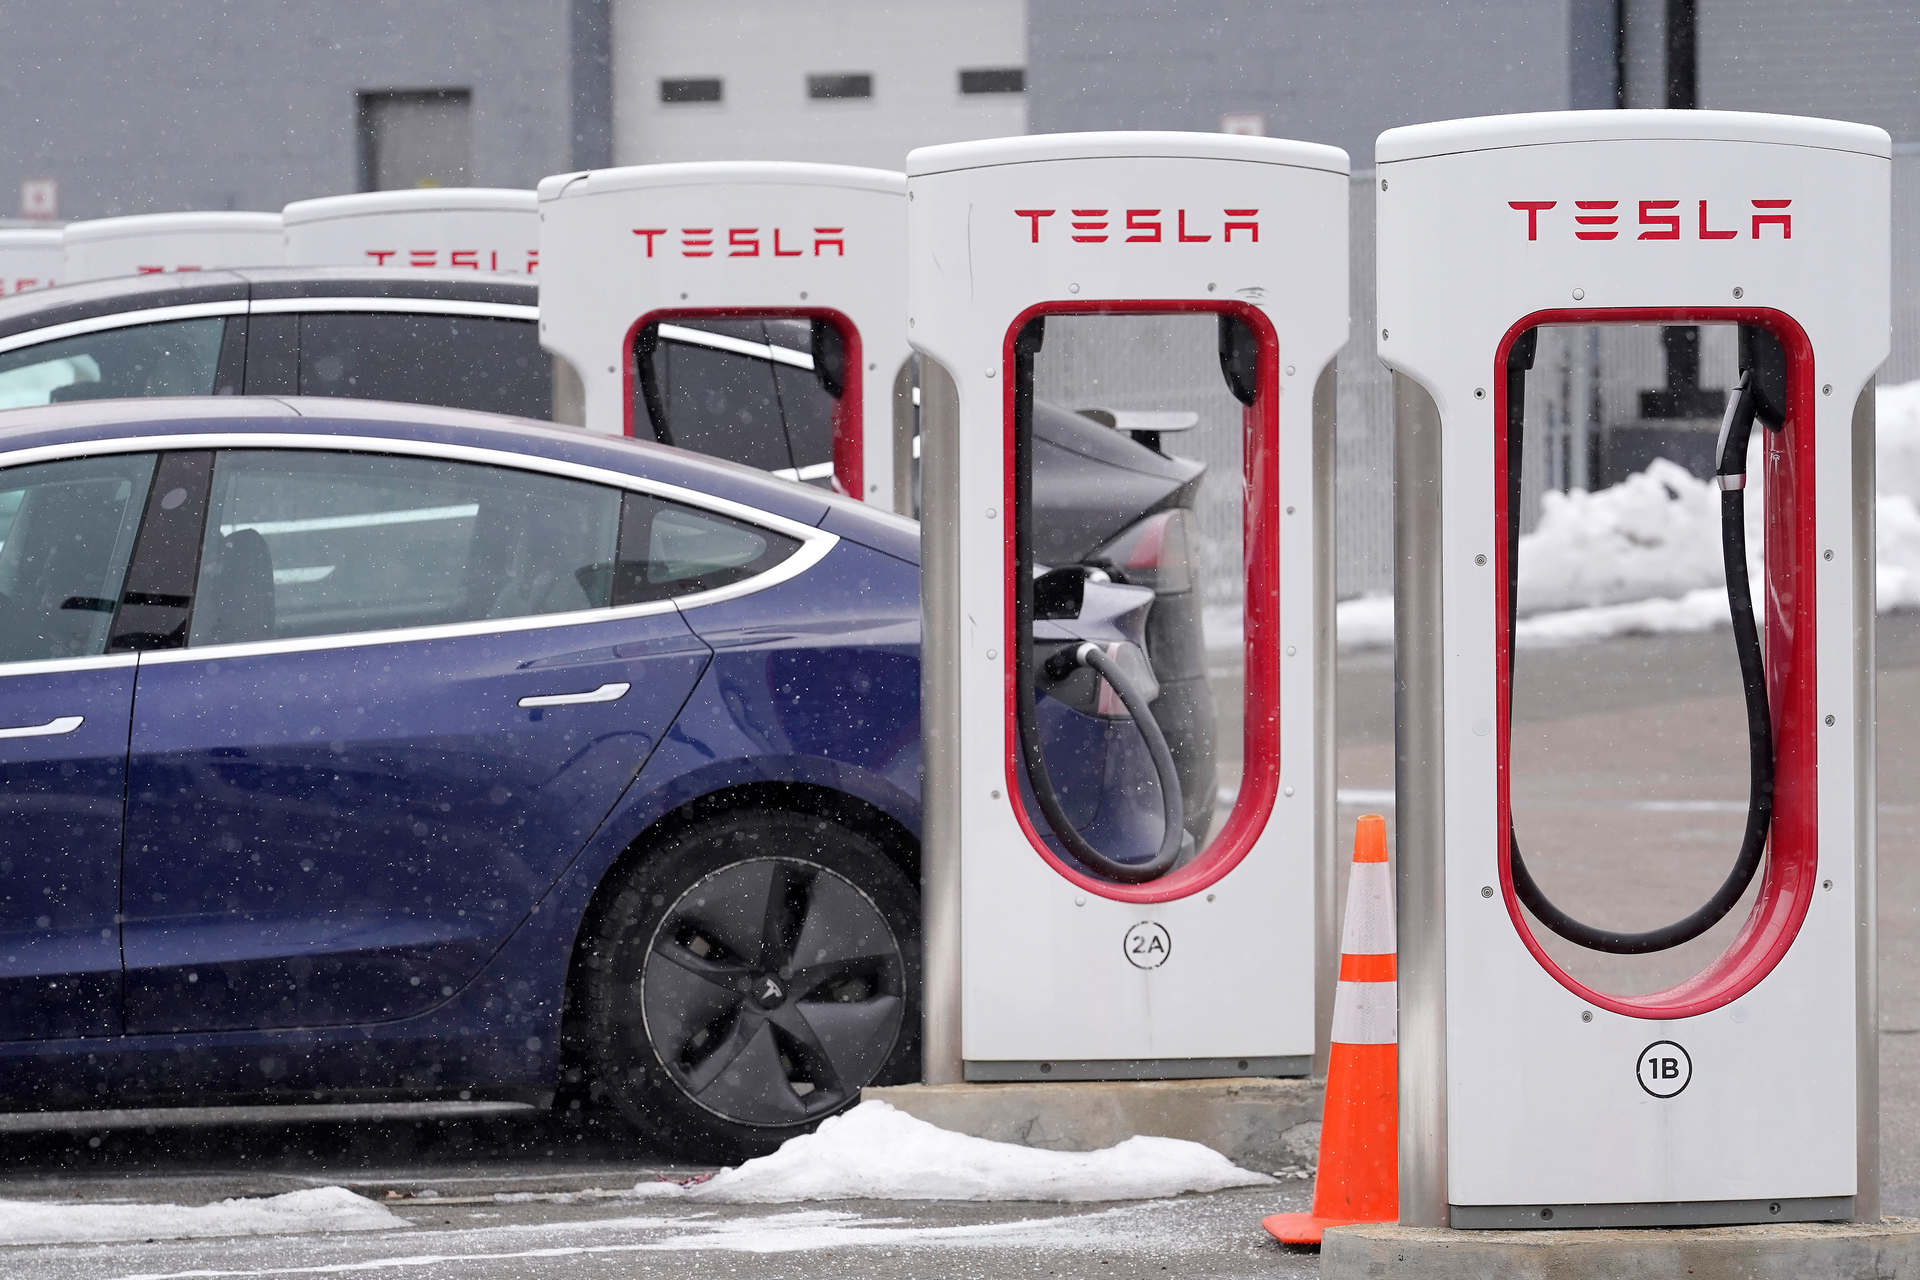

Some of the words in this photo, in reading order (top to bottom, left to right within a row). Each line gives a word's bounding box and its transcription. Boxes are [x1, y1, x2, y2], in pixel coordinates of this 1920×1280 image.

[1014, 208, 1259, 244] TESLA
[1507, 199, 1792, 241] TESLA
[632, 227, 845, 258] TESLA
[1132, 935, 1165, 954] 2A
[1648, 1057, 1680, 1080] 1B
